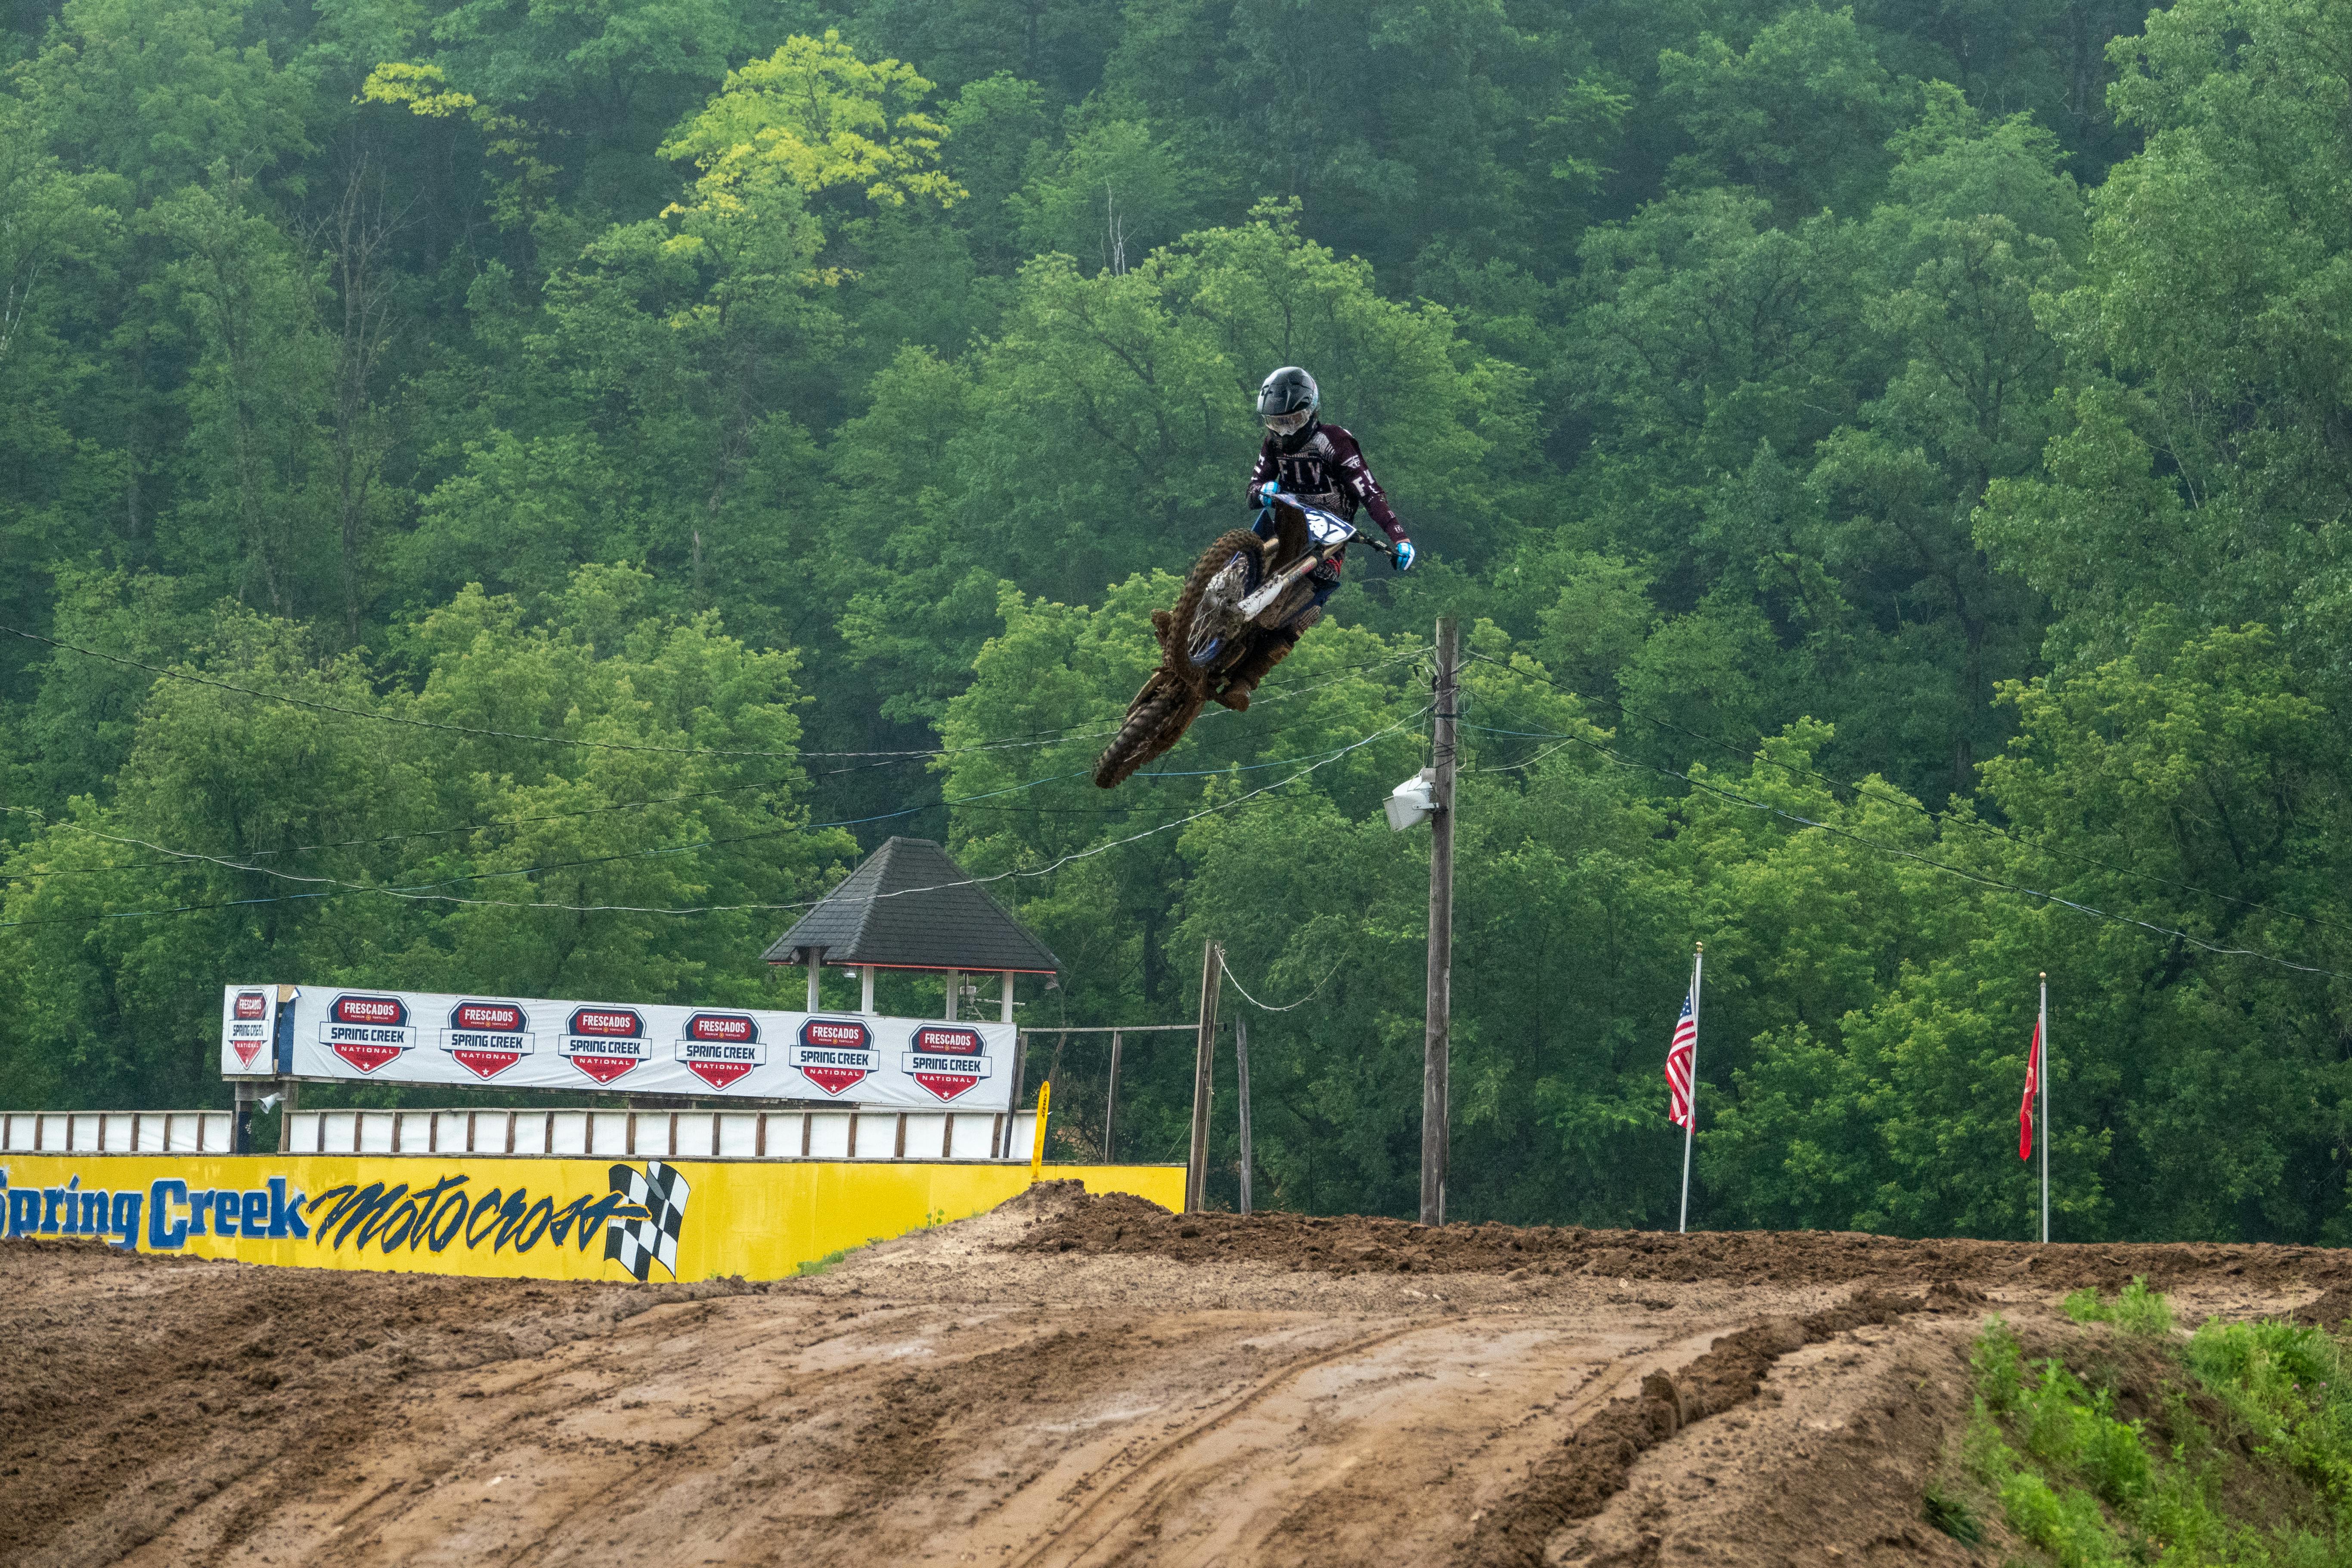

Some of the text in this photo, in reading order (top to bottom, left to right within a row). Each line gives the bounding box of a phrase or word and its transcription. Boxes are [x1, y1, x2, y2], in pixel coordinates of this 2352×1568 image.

[344, 1002, 394, 1016] FRESCADOS
[465, 1009, 513, 1022] FRESCADOS
[583, 1015, 630, 1028] FRESCADOS
[699, 1020, 745, 1033] FRESCADOS
[233, 1025, 250, 1036] SPRING
[331, 1027, 404, 1043] SPRING CREEK
[813, 1026, 858, 1039] FRESCADOS
[452, 1034, 523, 1049] SPRING CREEK
[925, 1033, 970, 1046] FRESCADOS
[570, 1040, 640, 1054] SPRING CREEK
[687, 1045, 755, 1060] SPRING CREEK
[800, 1050, 869, 1066] SPRING CREEK
[913, 1057, 981, 1072] SPRING CREEK
[0, 1166, 144, 1249] pring
[149, 1176, 310, 1249] Creek
